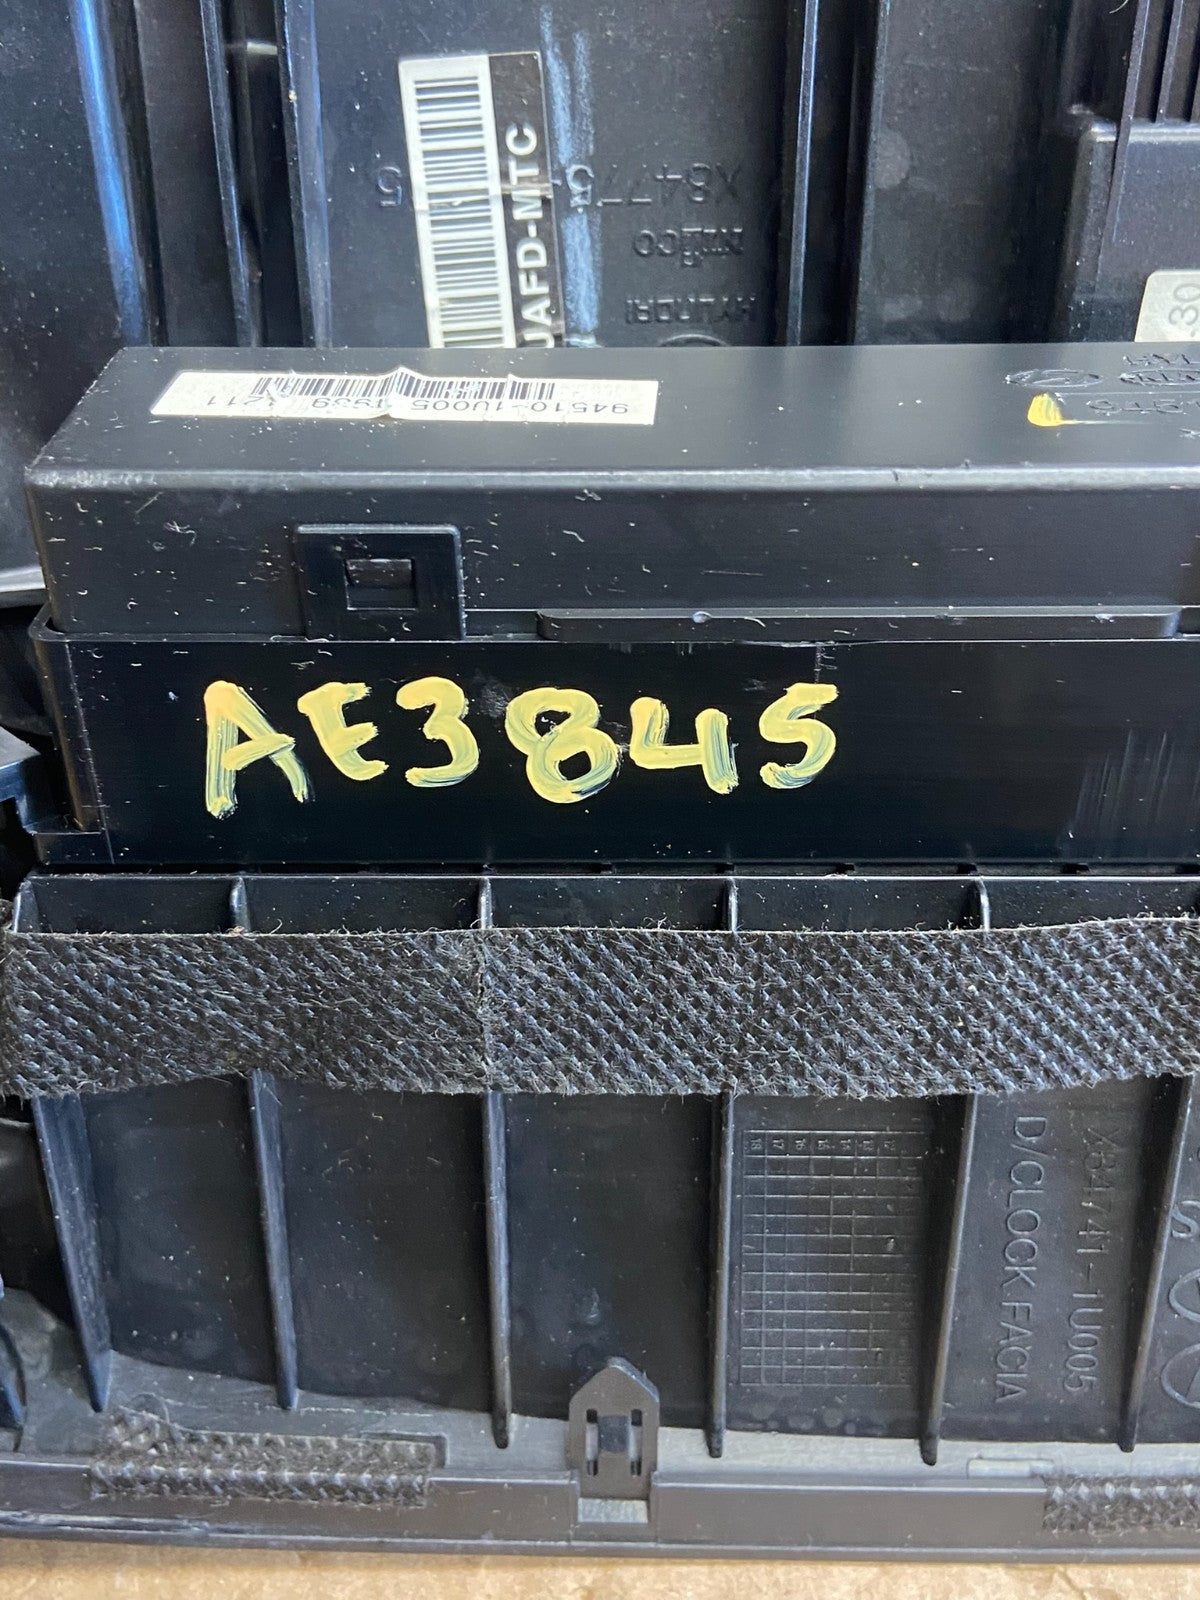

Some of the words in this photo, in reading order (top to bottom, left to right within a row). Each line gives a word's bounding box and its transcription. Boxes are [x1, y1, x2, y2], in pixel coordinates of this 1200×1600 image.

[411, 400, 628, 416] 94510-1U005
[204, 676, 838, 819] AE3845
[1001, 1115, 1049, 1289] D/CLOCK
[995, 1301, 1034, 1402] FACIA
